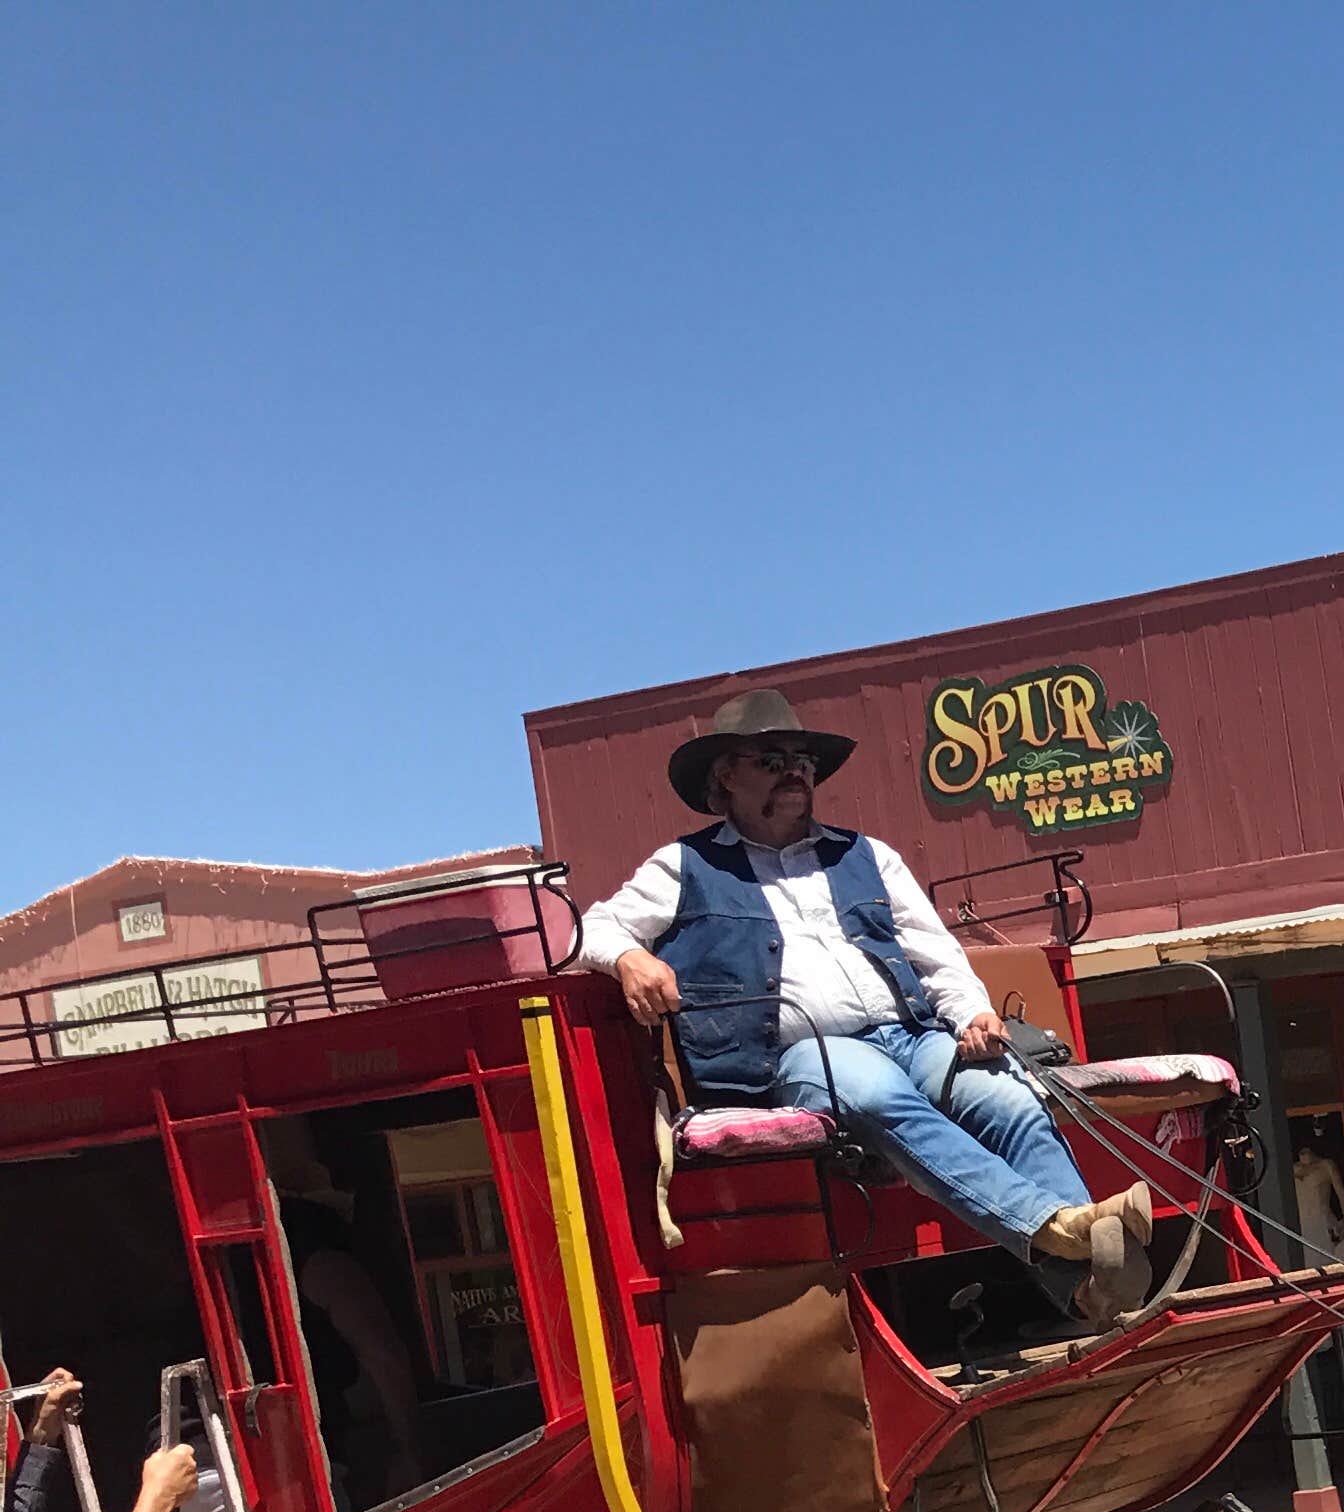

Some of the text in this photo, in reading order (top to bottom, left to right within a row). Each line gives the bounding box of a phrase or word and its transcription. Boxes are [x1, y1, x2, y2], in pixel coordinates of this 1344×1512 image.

[928, 674, 1108, 794] SPUR
[985, 750, 1165, 803] WESTERN
[1023, 788, 1136, 828] WEAR
[126, 911, 162, 935] 1880
